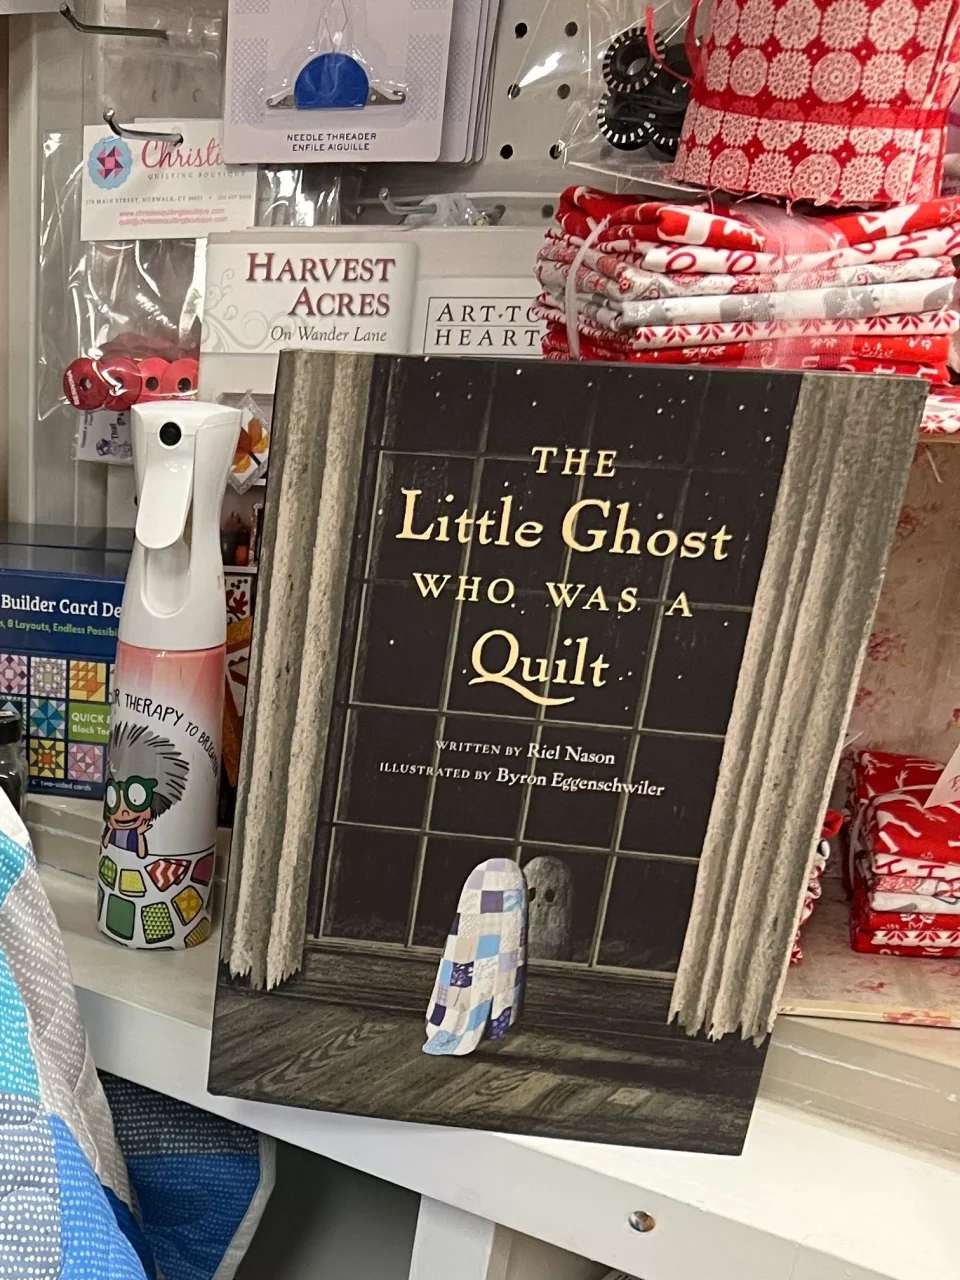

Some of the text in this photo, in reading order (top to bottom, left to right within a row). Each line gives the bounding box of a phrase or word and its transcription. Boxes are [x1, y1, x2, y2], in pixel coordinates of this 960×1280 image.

[286, 132, 377, 142] NEEDLE THREADER
[292, 143, 370, 152] ENFILE AIGUILLE
[141, 137, 224, 169] Christi
[147, 170, 246, 180] QUILTING BOUTIQUE
[115, 197, 141, 205] STREET,
[142, 196, 175, 204] NORWALK,
[245, 252, 396, 283] HARVEST
[288, 286, 390, 318] ACRES
[270, 325, 388, 342] On Wander Lane
[433, 328, 540, 347] HEART
[531, 446, 618, 478] THE
[395, 489, 733, 561] Little Ghost
[1, 594, 57, 613] Builder
[59, 599, 99, 617] Card
[102, 602, 122, 619] De
[412, 572, 693, 618] WHO WAS A
[15, 620, 52, 633] Layouts,
[53, 623, 86, 636] Endless
[87, 625, 119, 637] Possibi
[468, 629, 610, 706] Quilt
[71, 712, 104, 724] QUICK
[113, 688, 121, 707] R
[124, 693, 185, 726] THERAPY
[184, 721, 199, 737] TO
[72, 724, 110, 736] Block Too
[435, 740, 616, 765] WRITTEN BY Riel Nason
[73, 784, 92, 792] cards
[379, 762, 665, 797] ILLUSTRATED BY Byron Eggenschwiler
